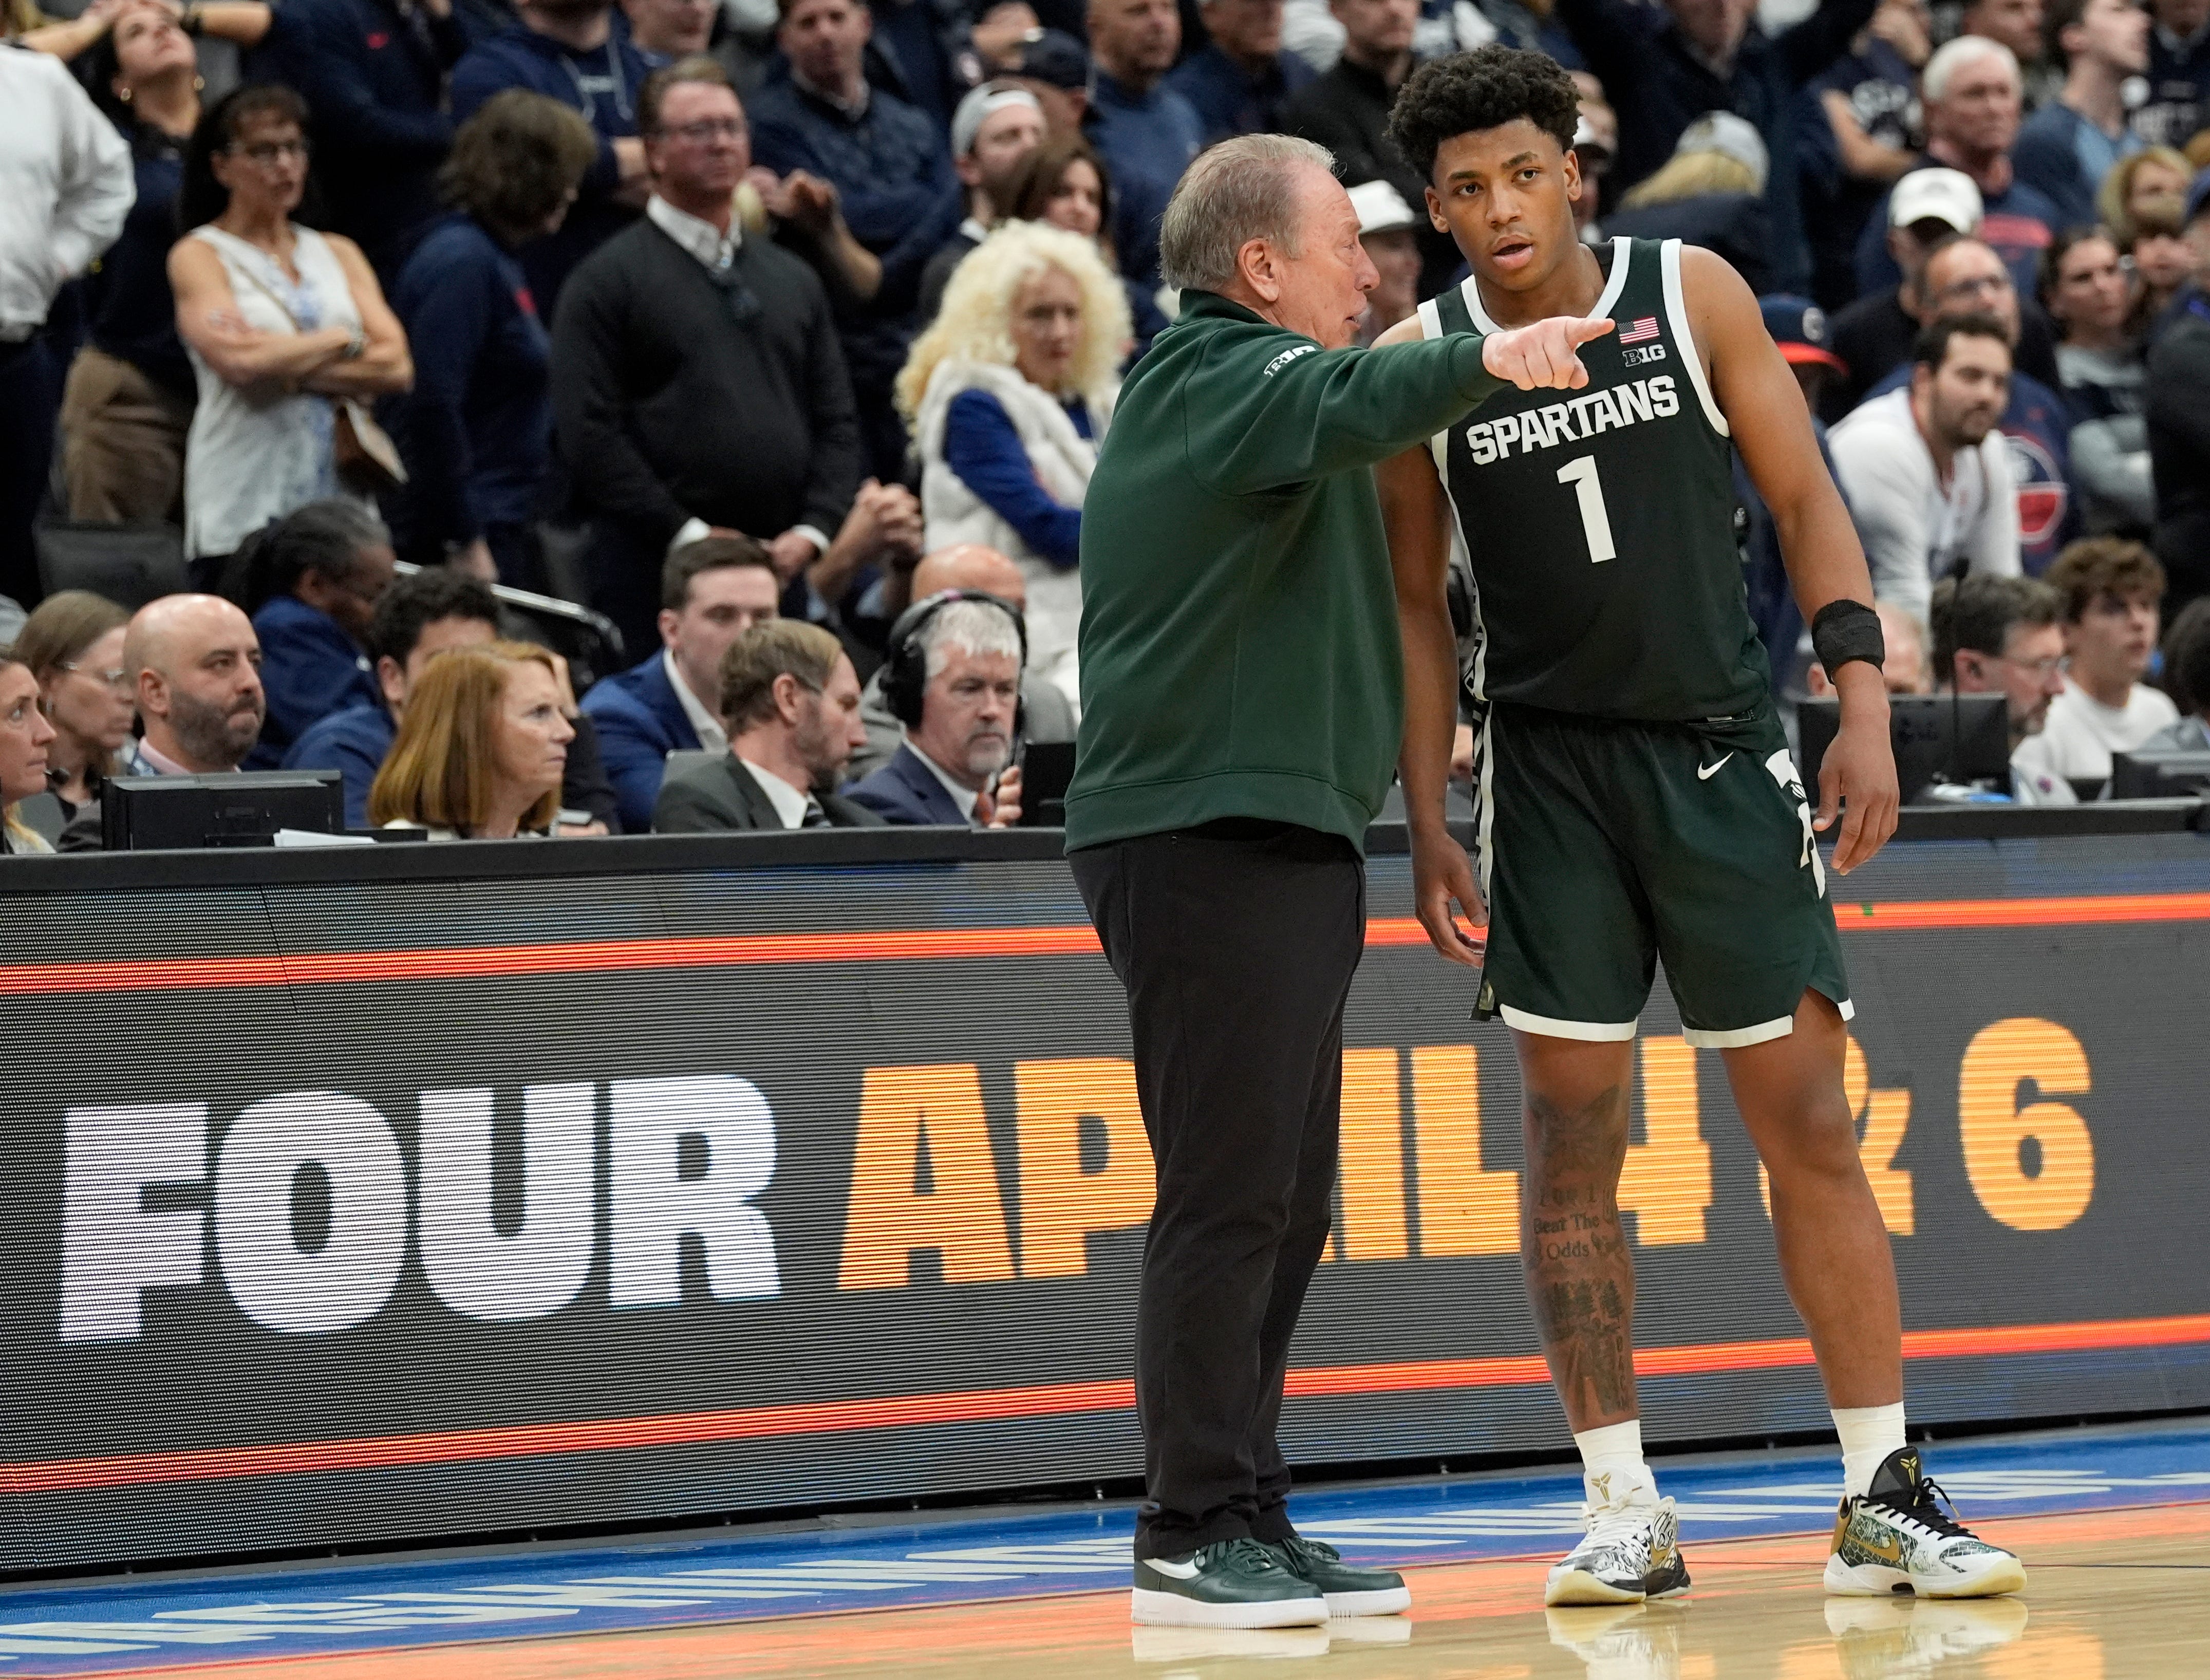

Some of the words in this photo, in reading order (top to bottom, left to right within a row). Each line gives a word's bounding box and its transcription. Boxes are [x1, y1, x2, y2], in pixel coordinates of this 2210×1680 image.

[1466, 375, 1680, 465] SPARTANS
[1556, 455, 1617, 563] 1
[58, 1072, 782, 1347] FOUR
[835, 1044, 1522, 1291] APIL
[1958, 1017, 2096, 1232] 6
[1570, 1211, 1599, 1230] The
[1546, 1240, 1589, 1260] Odds
